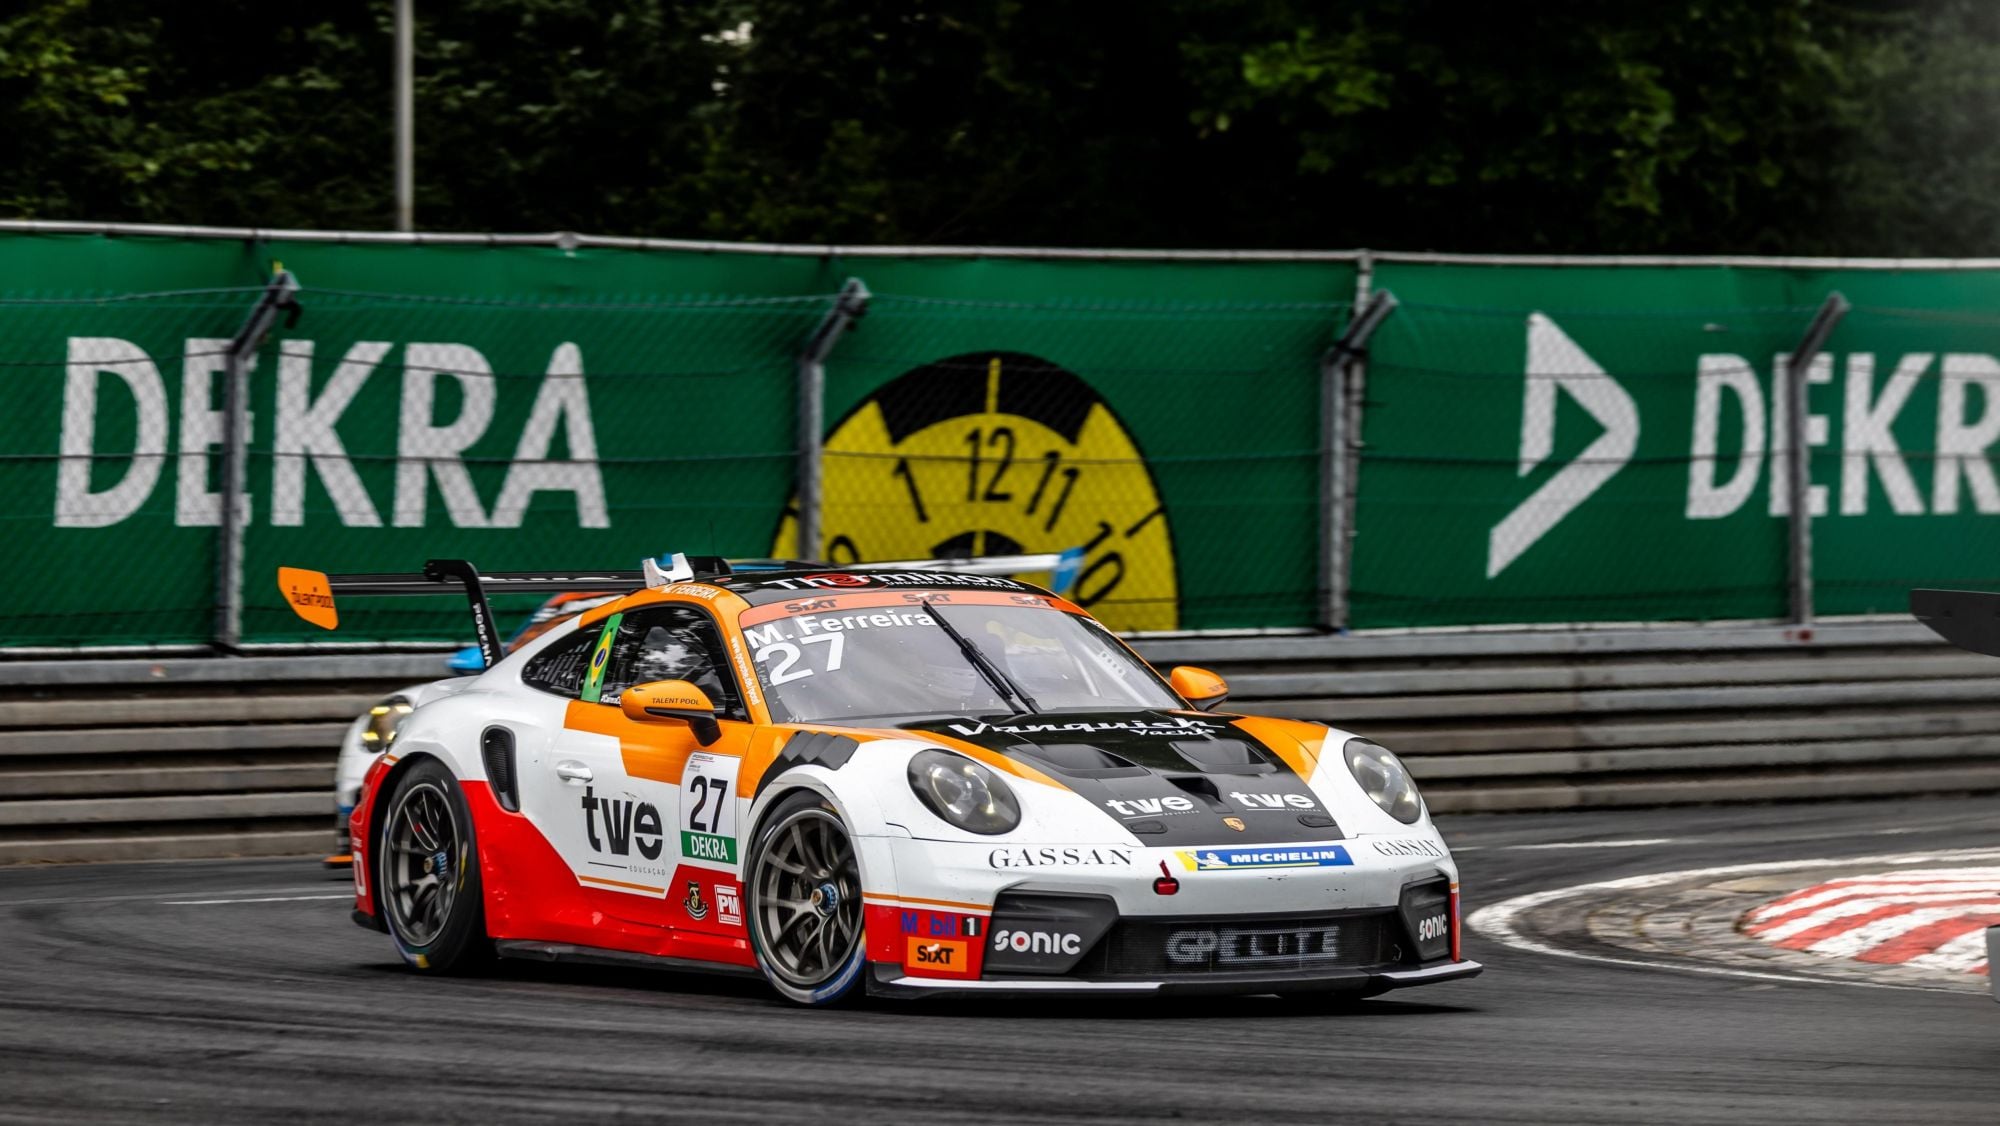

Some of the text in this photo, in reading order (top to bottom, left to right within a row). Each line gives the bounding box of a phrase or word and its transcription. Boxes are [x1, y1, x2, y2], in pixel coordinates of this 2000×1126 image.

[53, 336, 610, 528] DEKRA
[963, 427, 1017, 502] 12
[892, 457, 929, 523] 1
[1025, 450, 1081, 533] 11
[743, 609, 940, 650] M. Ferreira
[755, 631, 846, 687] 27
[652, 697, 679, 705] TALENT
[948, 716, 1226, 737] Vanquish
[689, 775, 729, 834] 27
[1105, 796, 1195, 816] twe
[1229, 791, 1316, 809] twe
[581, 785, 663, 861] twe
[690, 835, 729, 861] DEKRA
[988, 848, 1133, 869] GASSAN
[1230, 850, 1336, 863] MICHELIN
[1371, 840, 1445, 857] GASSAN
[717, 894, 740, 917] PM
